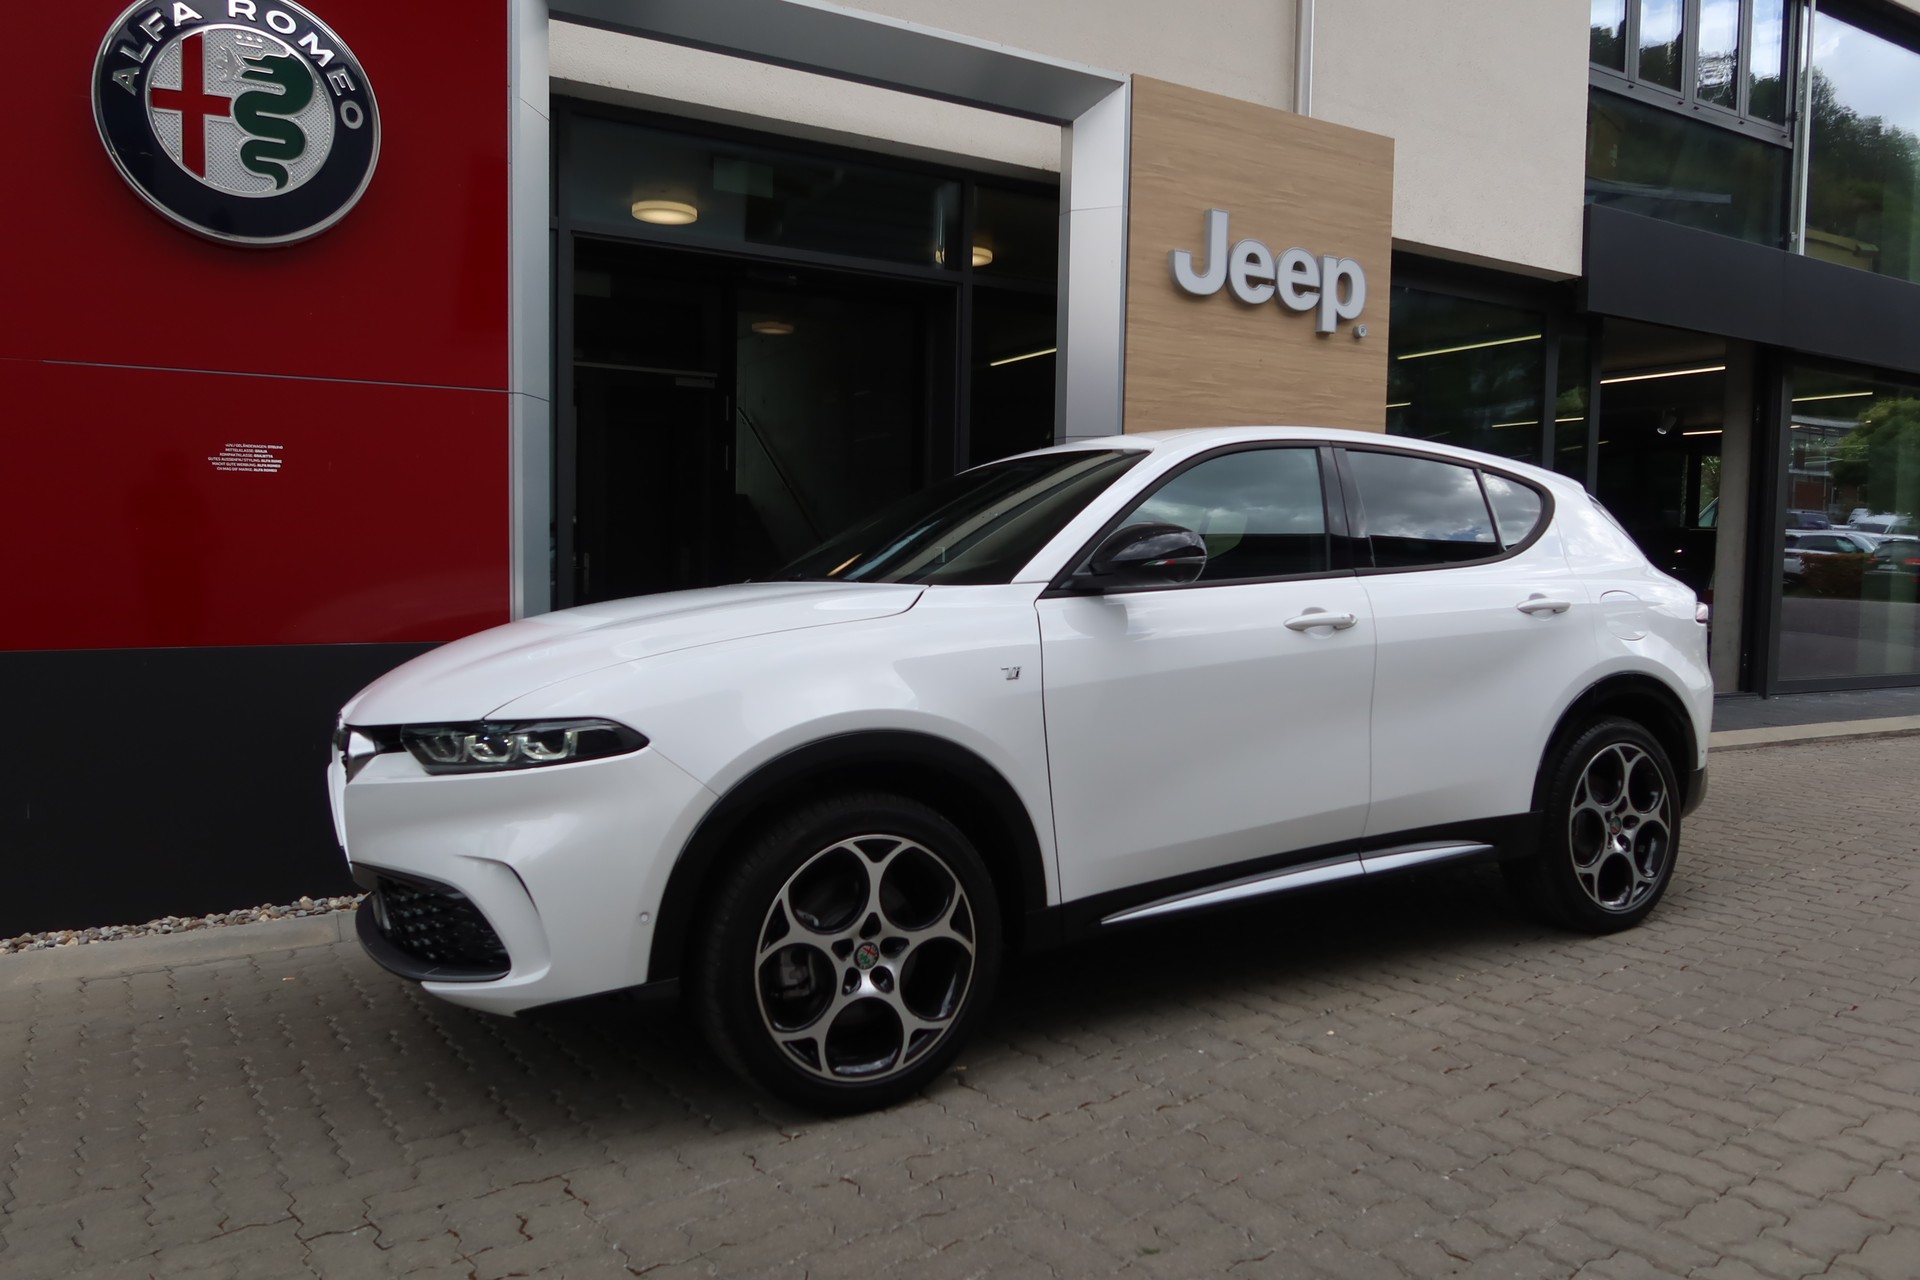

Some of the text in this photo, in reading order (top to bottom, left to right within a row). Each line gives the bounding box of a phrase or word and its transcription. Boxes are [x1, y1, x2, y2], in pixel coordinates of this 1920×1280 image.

[112, 0, 364, 129] ALFA ROMEO
[1168, 207, 1367, 334] Jeep
